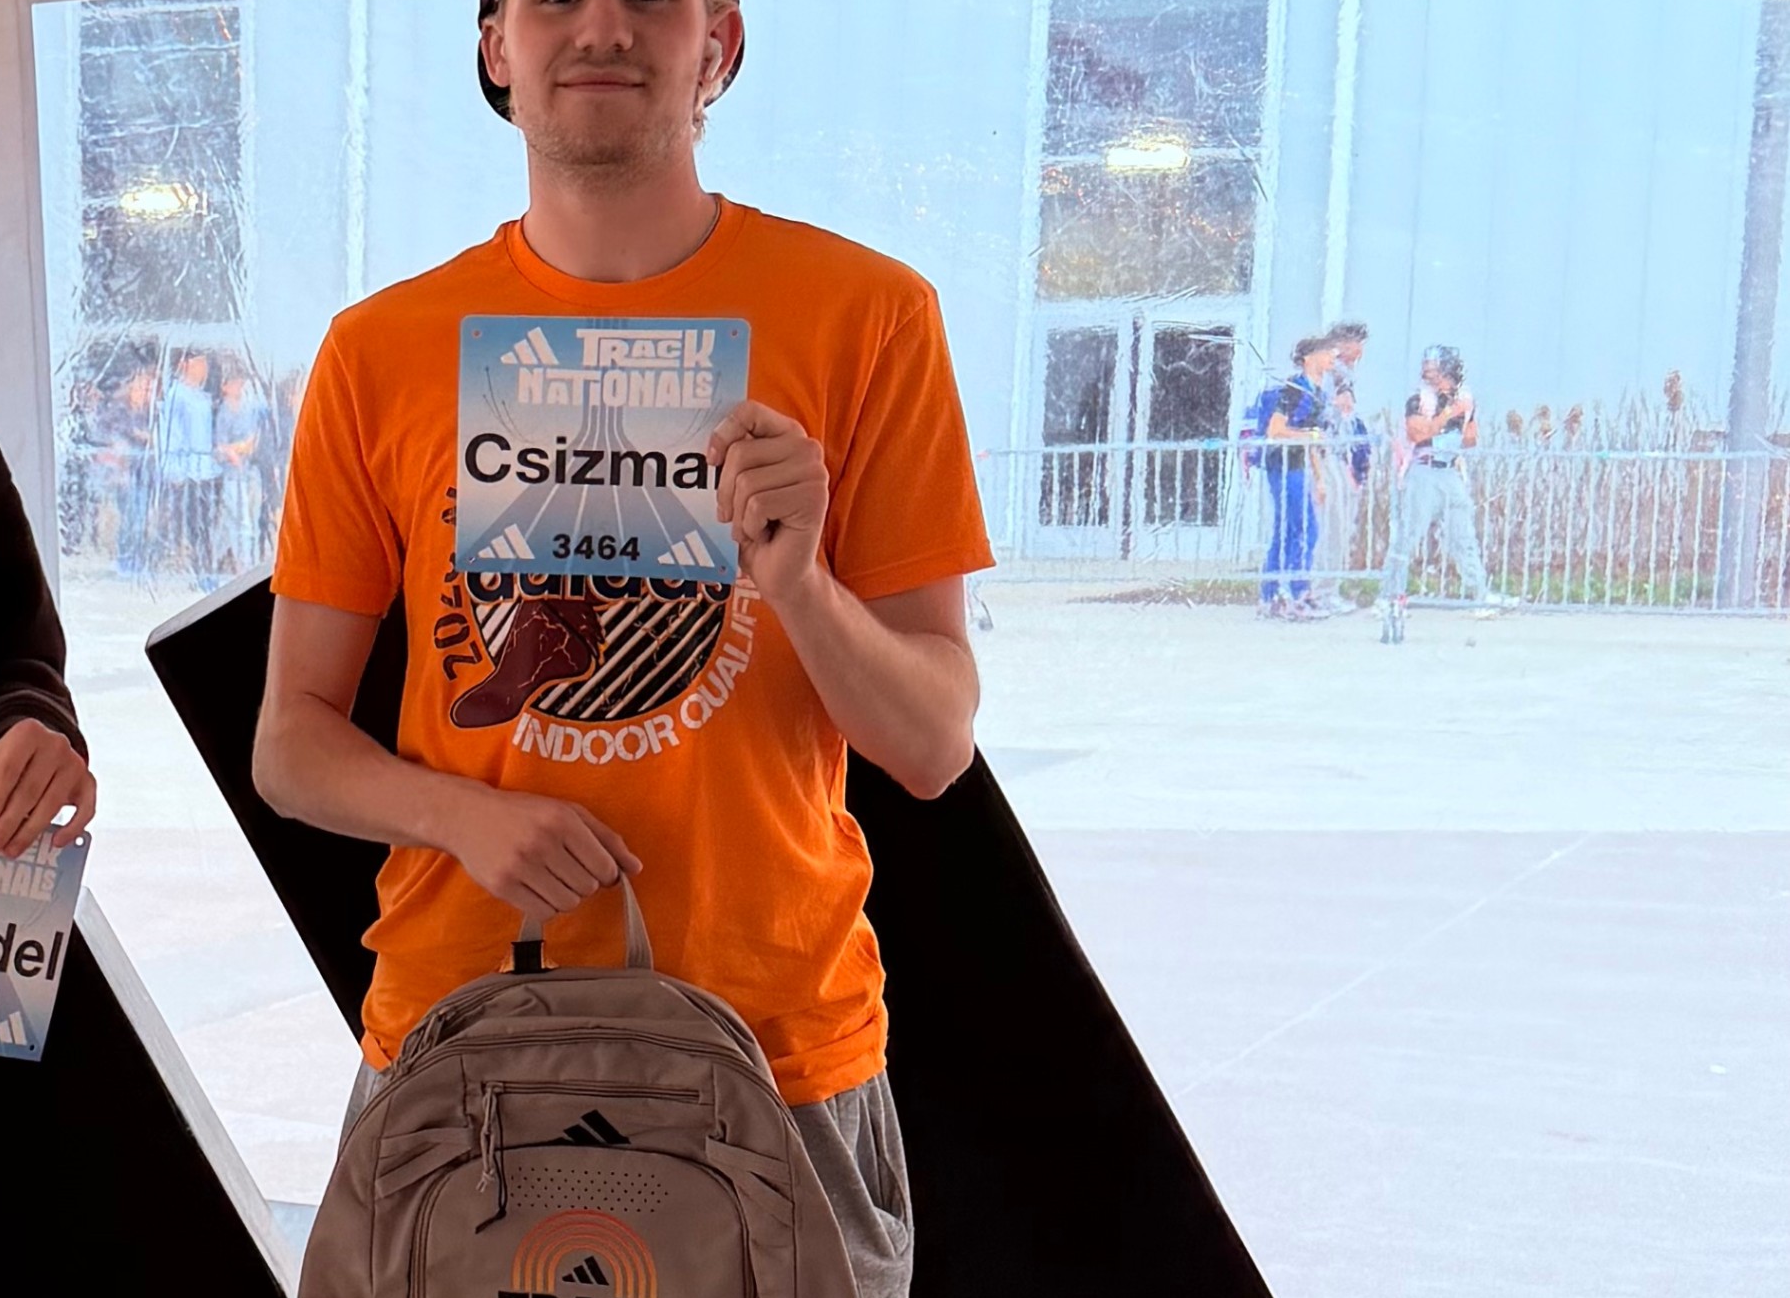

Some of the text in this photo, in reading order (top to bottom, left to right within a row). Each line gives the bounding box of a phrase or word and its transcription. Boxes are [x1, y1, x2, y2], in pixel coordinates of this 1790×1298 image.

[576, 328, 716, 369] TRACK
[518, 367, 714, 409] NATIONALS
[551, 533, 641, 562] 3464
[512, 713, 682, 765] INDOOR
